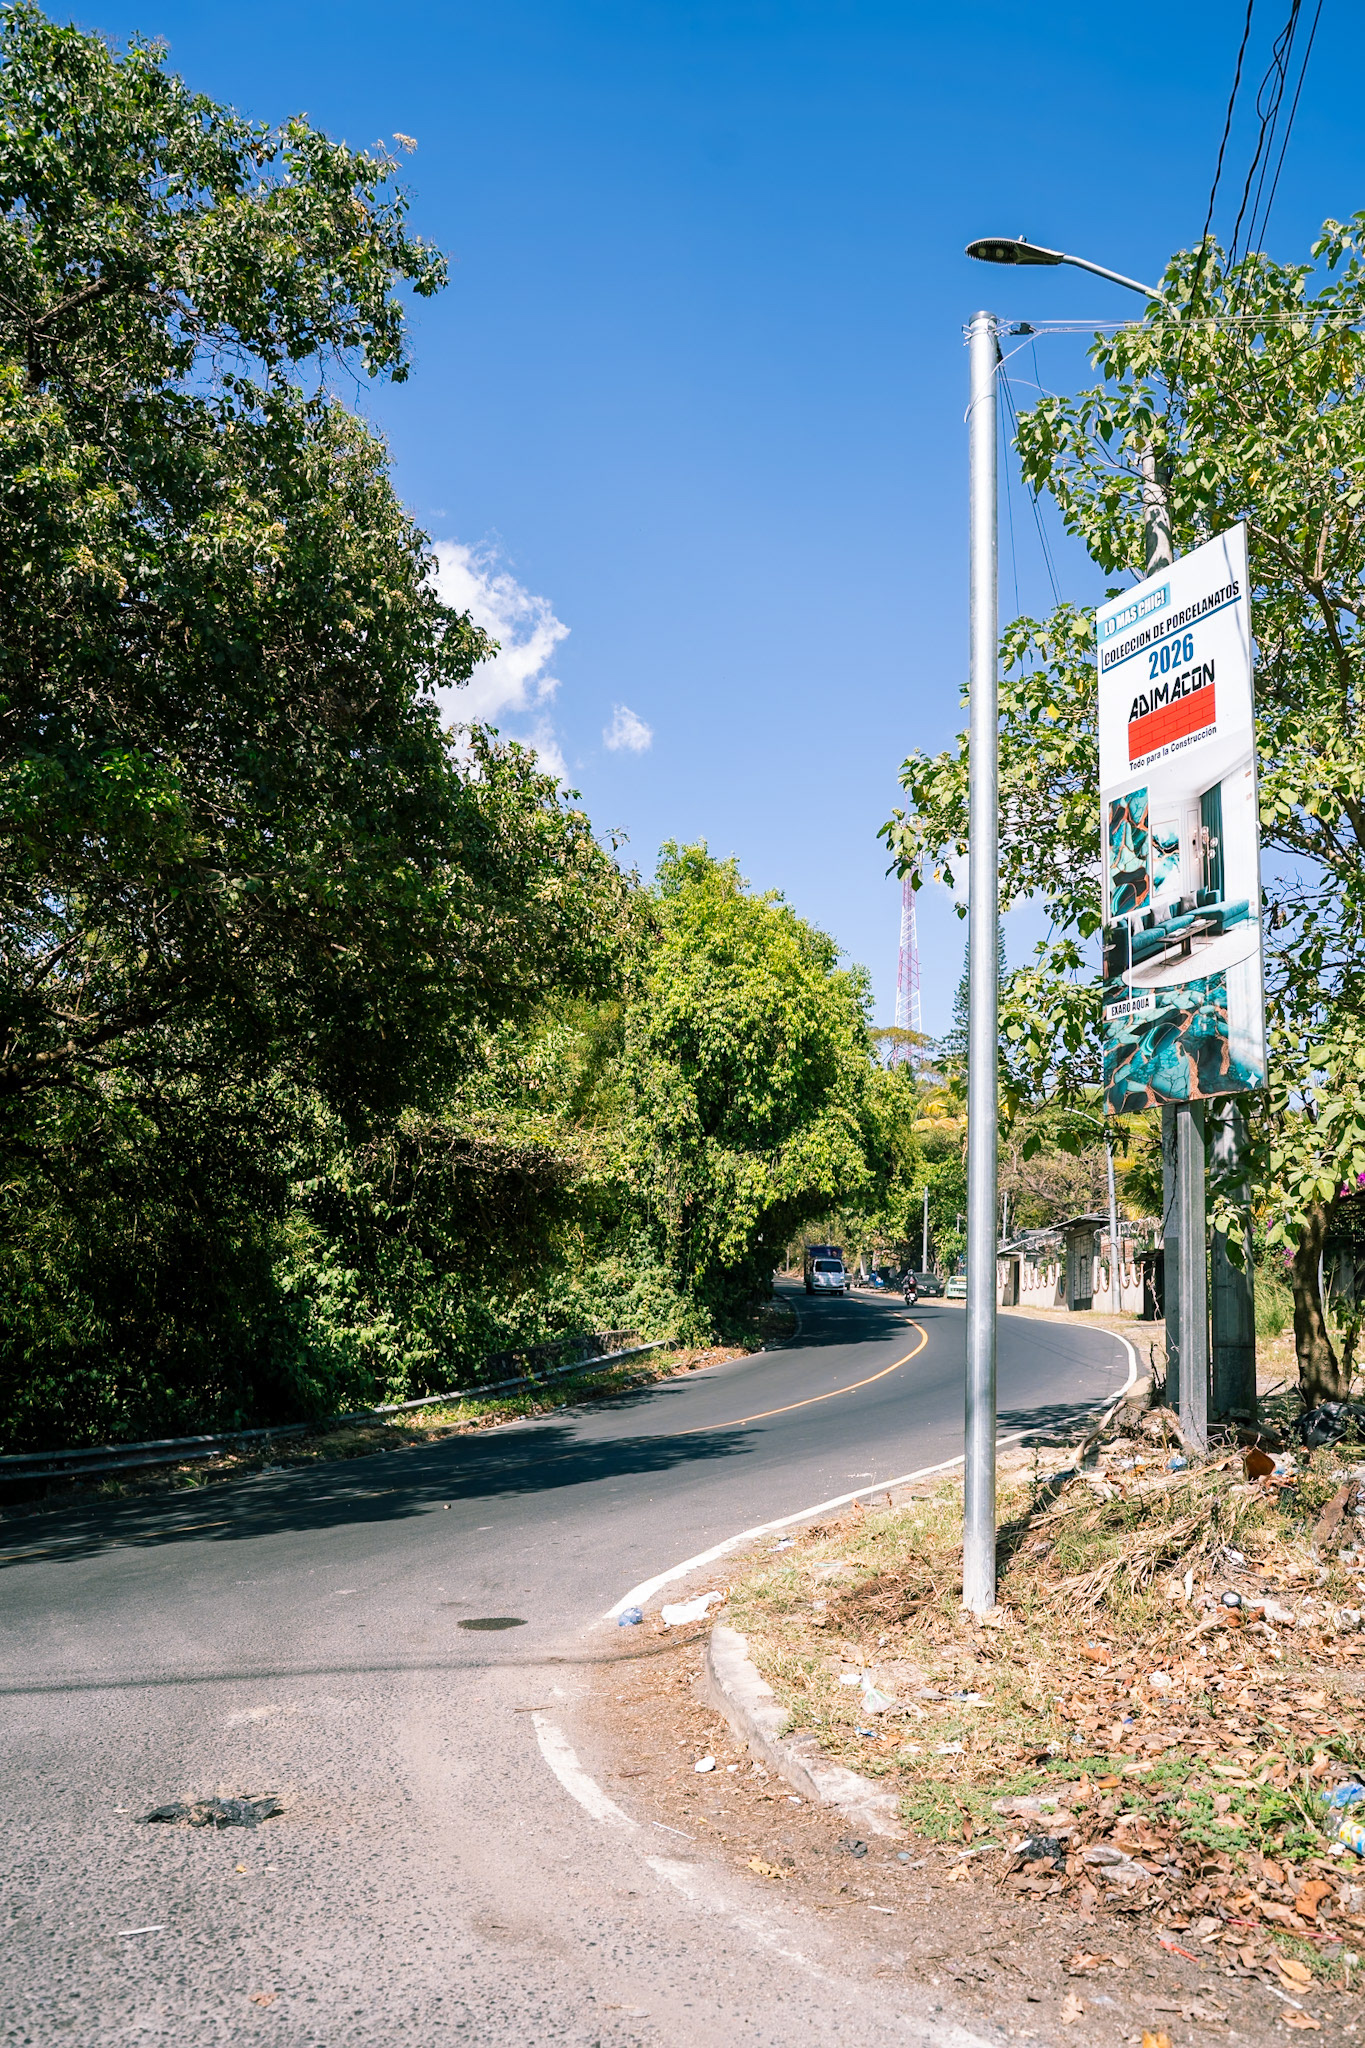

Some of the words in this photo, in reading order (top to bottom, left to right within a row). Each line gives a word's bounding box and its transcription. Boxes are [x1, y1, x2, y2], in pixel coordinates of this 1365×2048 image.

[1104, 618, 1115, 637] LO
[1116, 605, 1138, 631] MAS
[1139, 588, 1166, 617] CHIC!
[1104, 628, 1151, 666] COLECCION
[1153, 622, 1164, 639] DE
[1166, 580, 1239, 631] PORCELANATOS
[1148, 633, 1194, 680] 2026
[1128, 658, 1215, 723] ADIMACON
[1129, 759, 1145, 771] Todo
[1146, 751, 1161, 766] para
[1162, 747, 1169, 757] la
[1170, 726, 1217, 753] Construcción
[1111, 1002, 1131, 1017] EXARO
[1132, 997, 1150, 1011] AQUA
